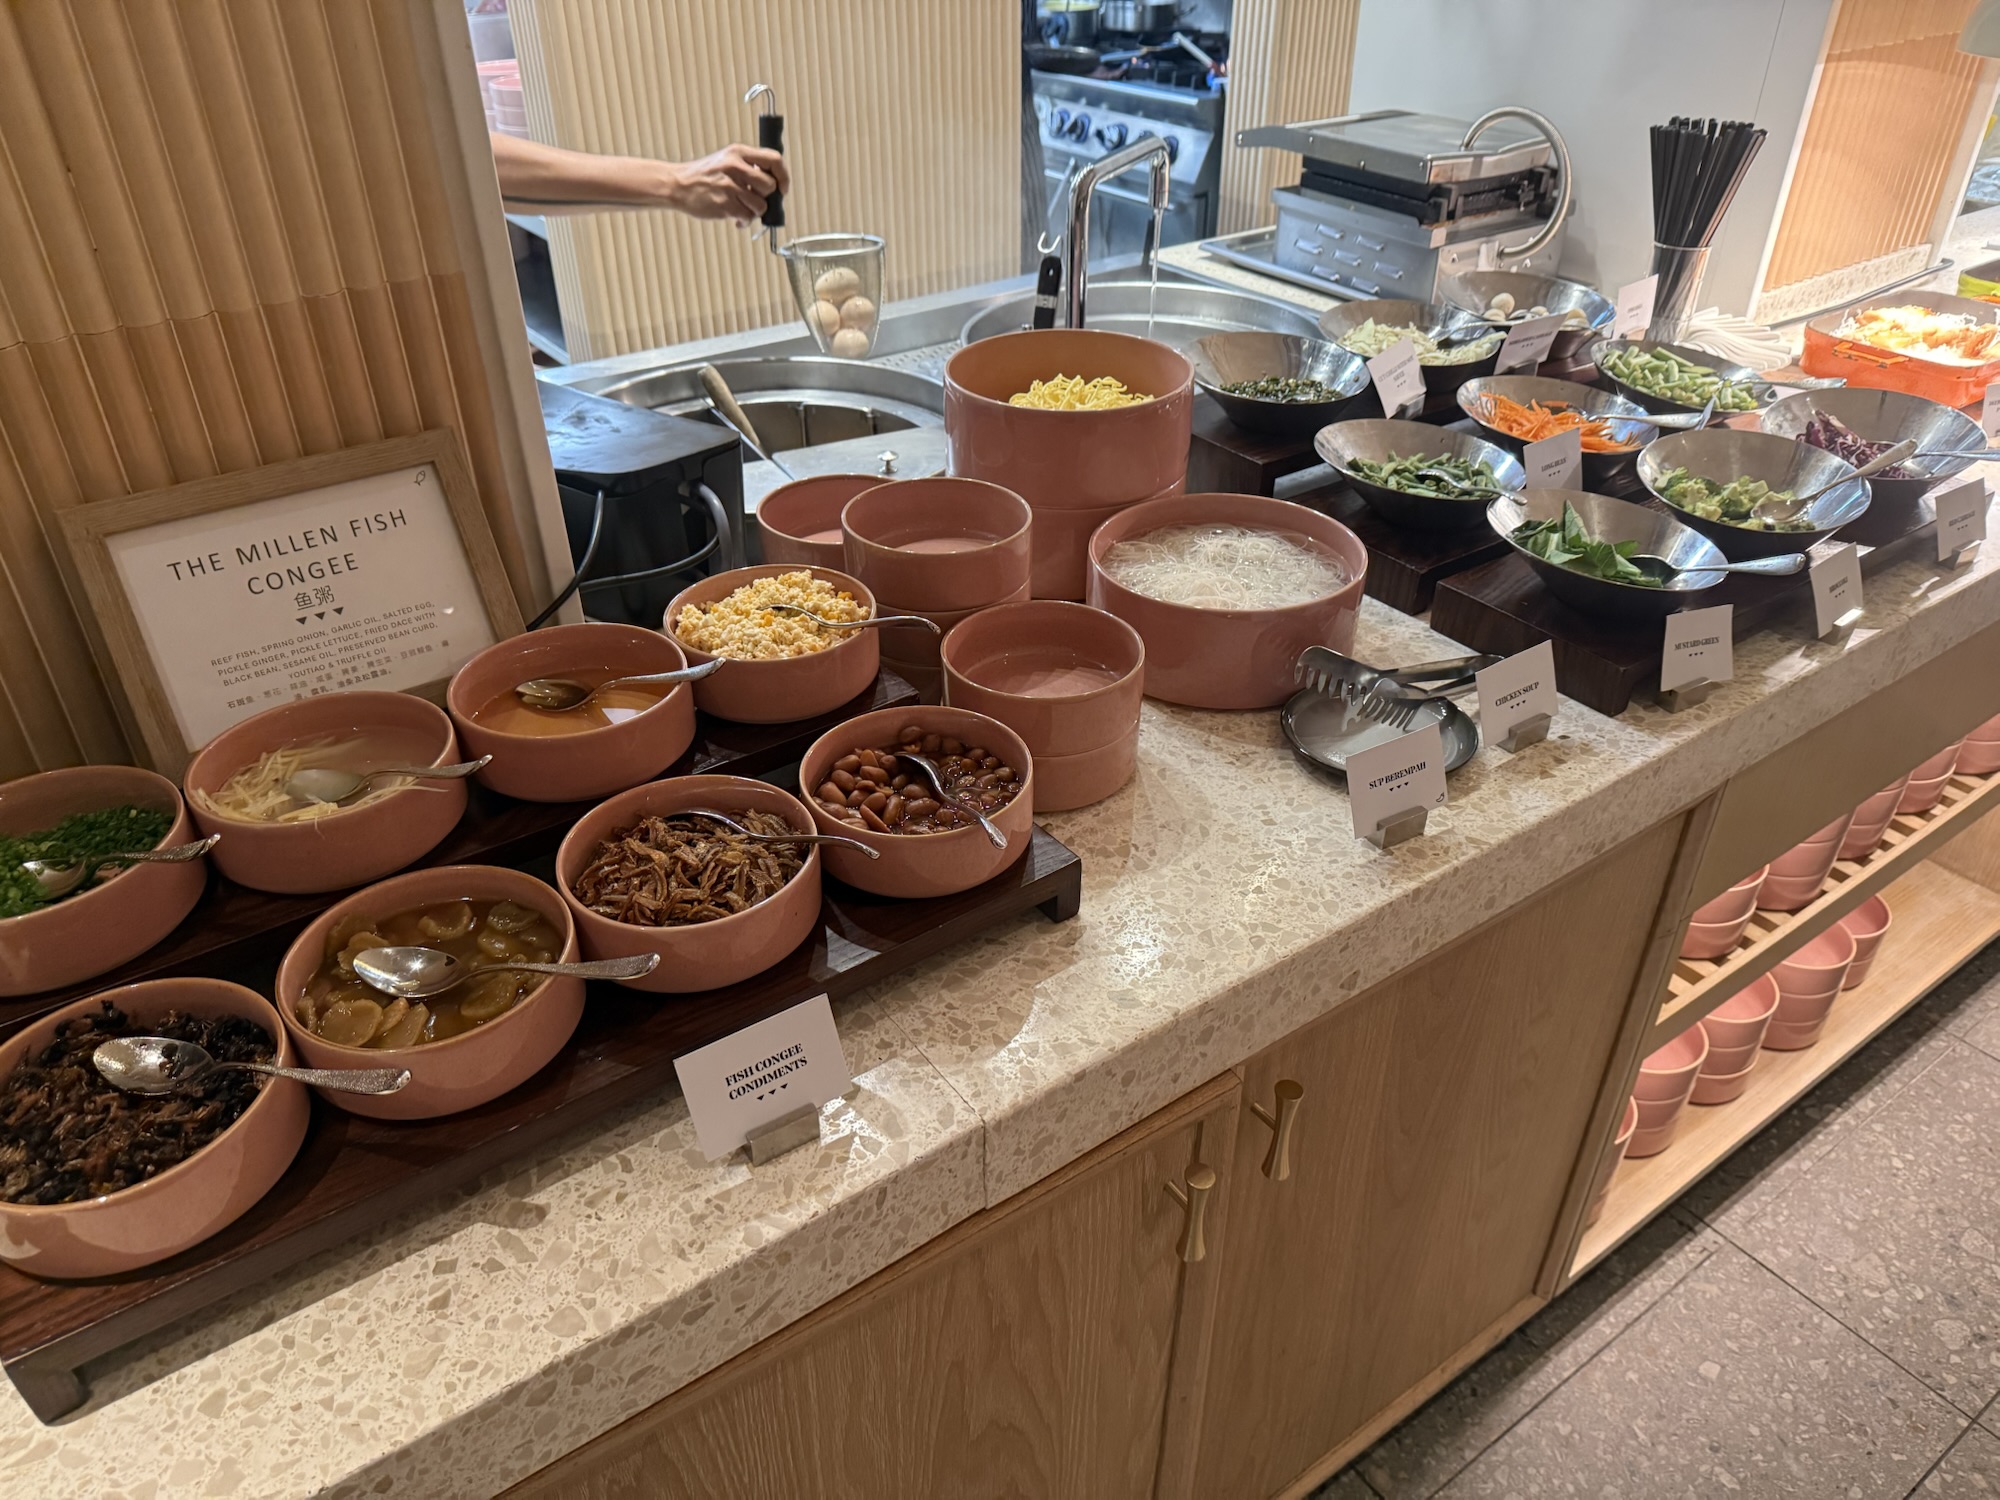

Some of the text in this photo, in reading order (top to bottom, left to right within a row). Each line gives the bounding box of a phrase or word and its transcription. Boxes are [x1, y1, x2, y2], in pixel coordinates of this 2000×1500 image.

[167, 508, 408, 581] THE MILLEN FISH
[247, 553, 360, 596] CONGEE
[294, 585, 335, 611] 鱼粥
[210, 655, 233, 667] REEF
[236, 648, 260, 661] FISH,
[261, 638, 295, 653] SPRING
[296, 630, 329, 643] ONION,
[331, 620, 362, 634] GARLIC
[382, 606, 413, 619] SALTED
[217, 611, 436, 677] PICKLE GINGER, PICKLE LETTUCE, FRIED DACE WITH
[223, 673, 253, 687] BLACK
[254, 665, 281, 678] BEAN,
[283, 655, 317, 670] SESAME
[338, 635, 386, 654] PRESERVED
[388, 629, 410, 641] BEAN
[1674, 636, 1720, 651] MUSTARD GREEN
[288, 664, 326, 679] YOUTIAO
[327, 662, 334, 670] &
[335, 653, 372, 668] TRUFFLE
[1495, 681, 1539, 707] CHICKEN SOUP
[1368, 761, 1427, 790] SUP BEREMPAH
[725, 1043, 804, 1087] FISH CONGEE
[728, 1056, 808, 1100] CONDIMENTS
